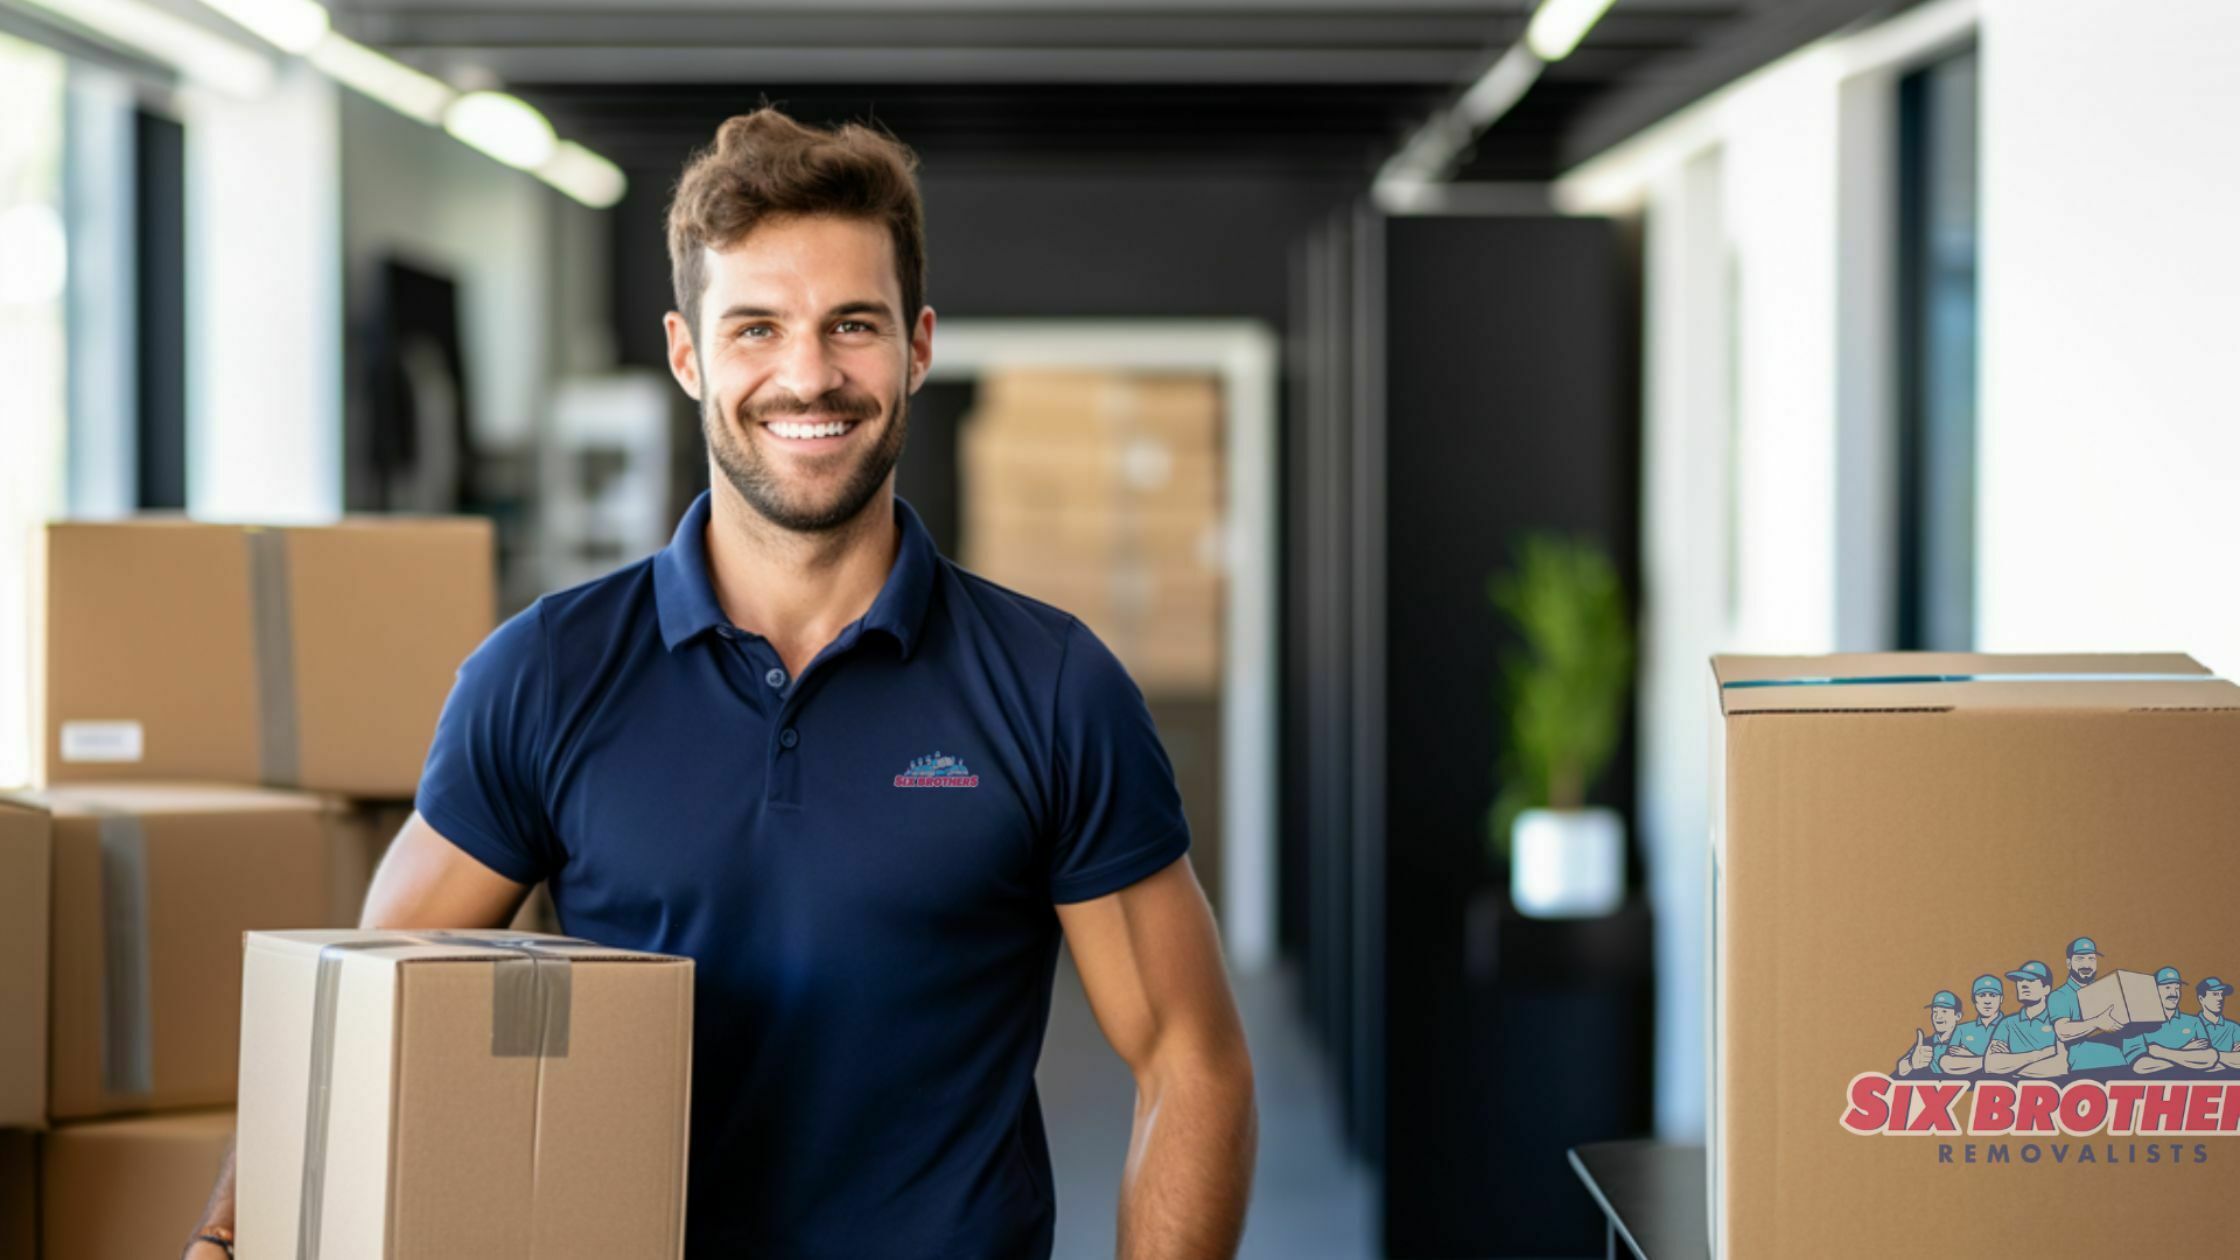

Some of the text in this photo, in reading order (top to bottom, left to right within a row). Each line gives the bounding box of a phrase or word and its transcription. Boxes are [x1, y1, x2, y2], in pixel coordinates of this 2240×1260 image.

[895, 775, 978, 787] SIX BROTHERS
[1843, 1074, 1963, 1134] SIX
[1938, 1143, 2208, 1164] REMOVALISTS
